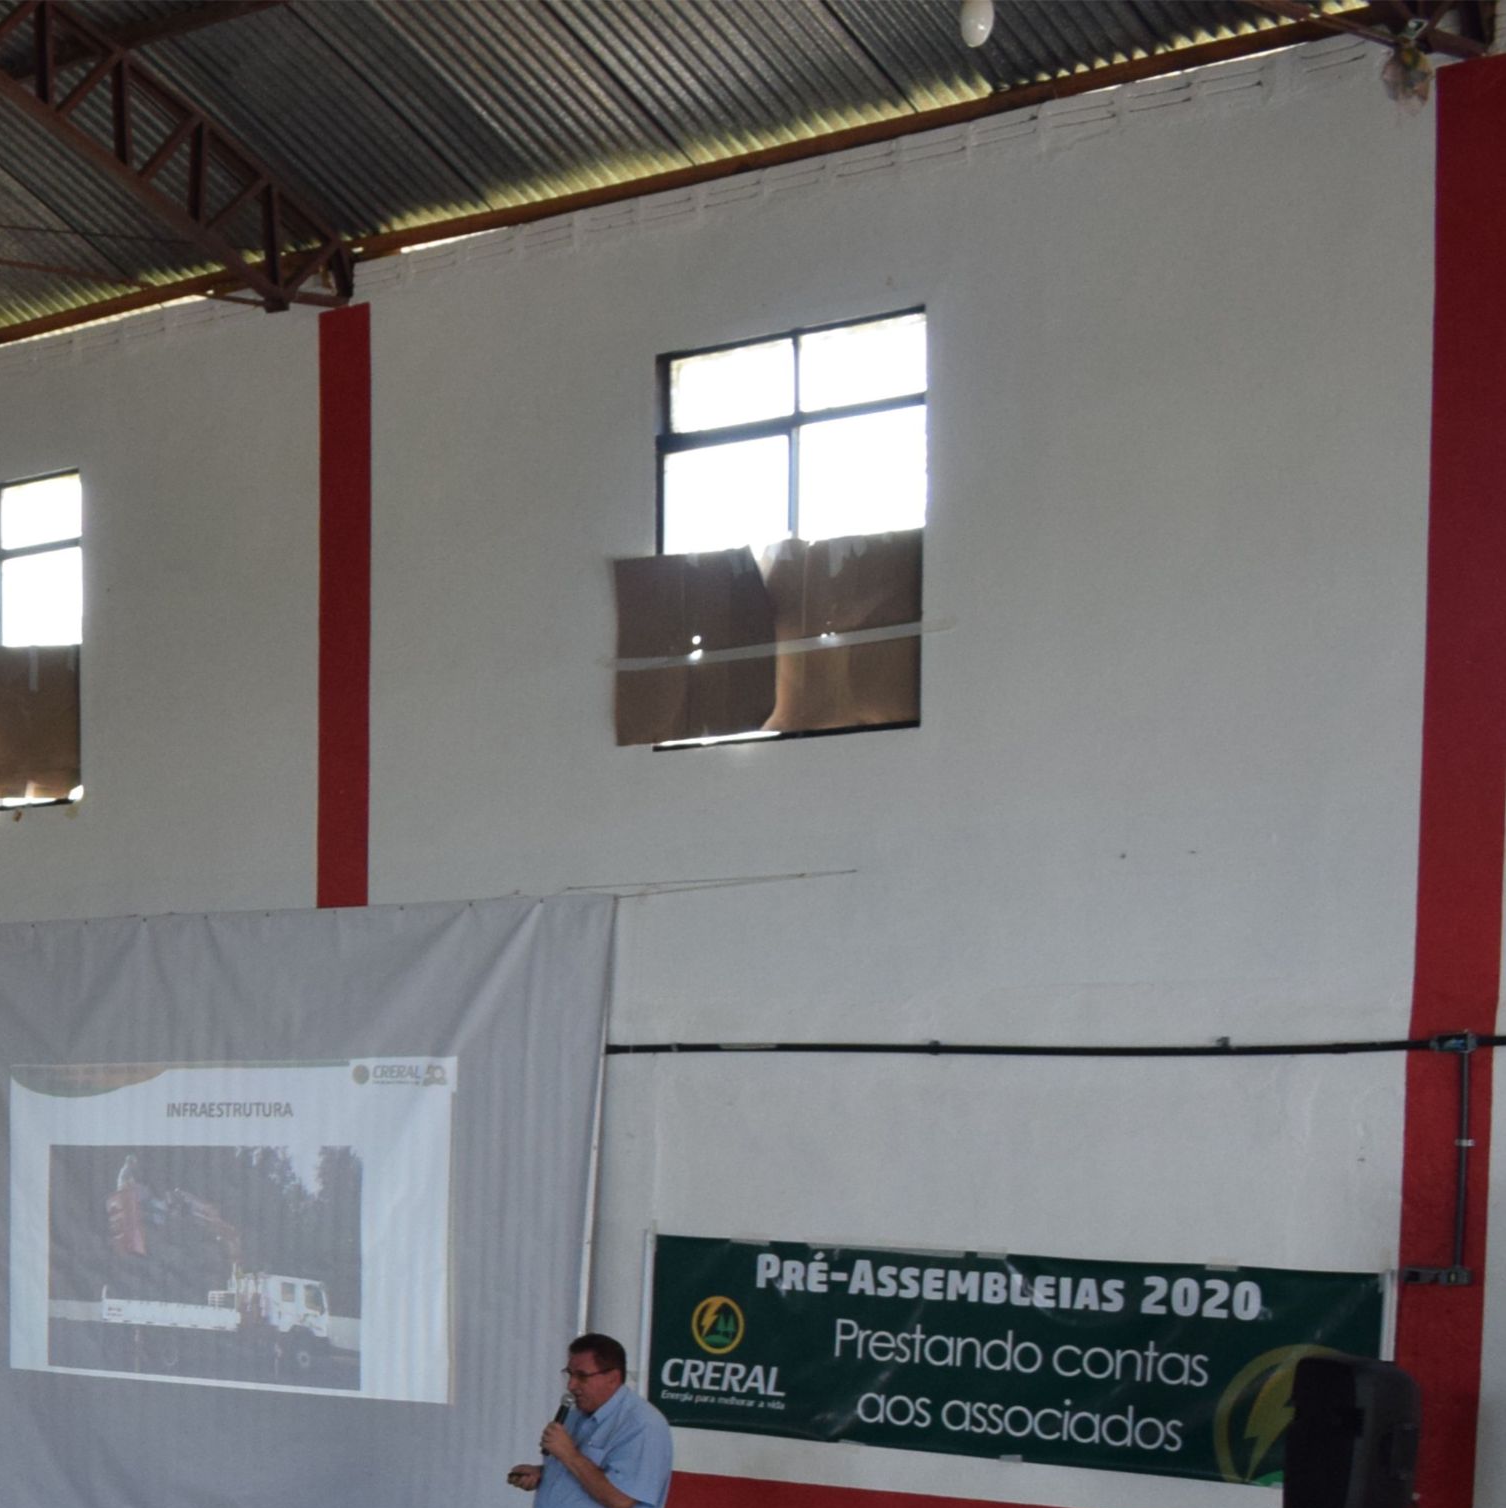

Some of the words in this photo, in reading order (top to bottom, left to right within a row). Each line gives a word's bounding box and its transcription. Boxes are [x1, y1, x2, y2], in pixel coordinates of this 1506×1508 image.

[166, 1102, 294, 1118] INFRAESTRUTURA
[1141, 1276, 1262, 1321] 2020
[834, 1318, 1042, 1374] Prestando
[1053, 1341, 1209, 1387] contas
[661, 1358, 786, 1397] CRERAL
[857, 1392, 931, 1428] aos
[941, 1399, 1183, 1452] associados
